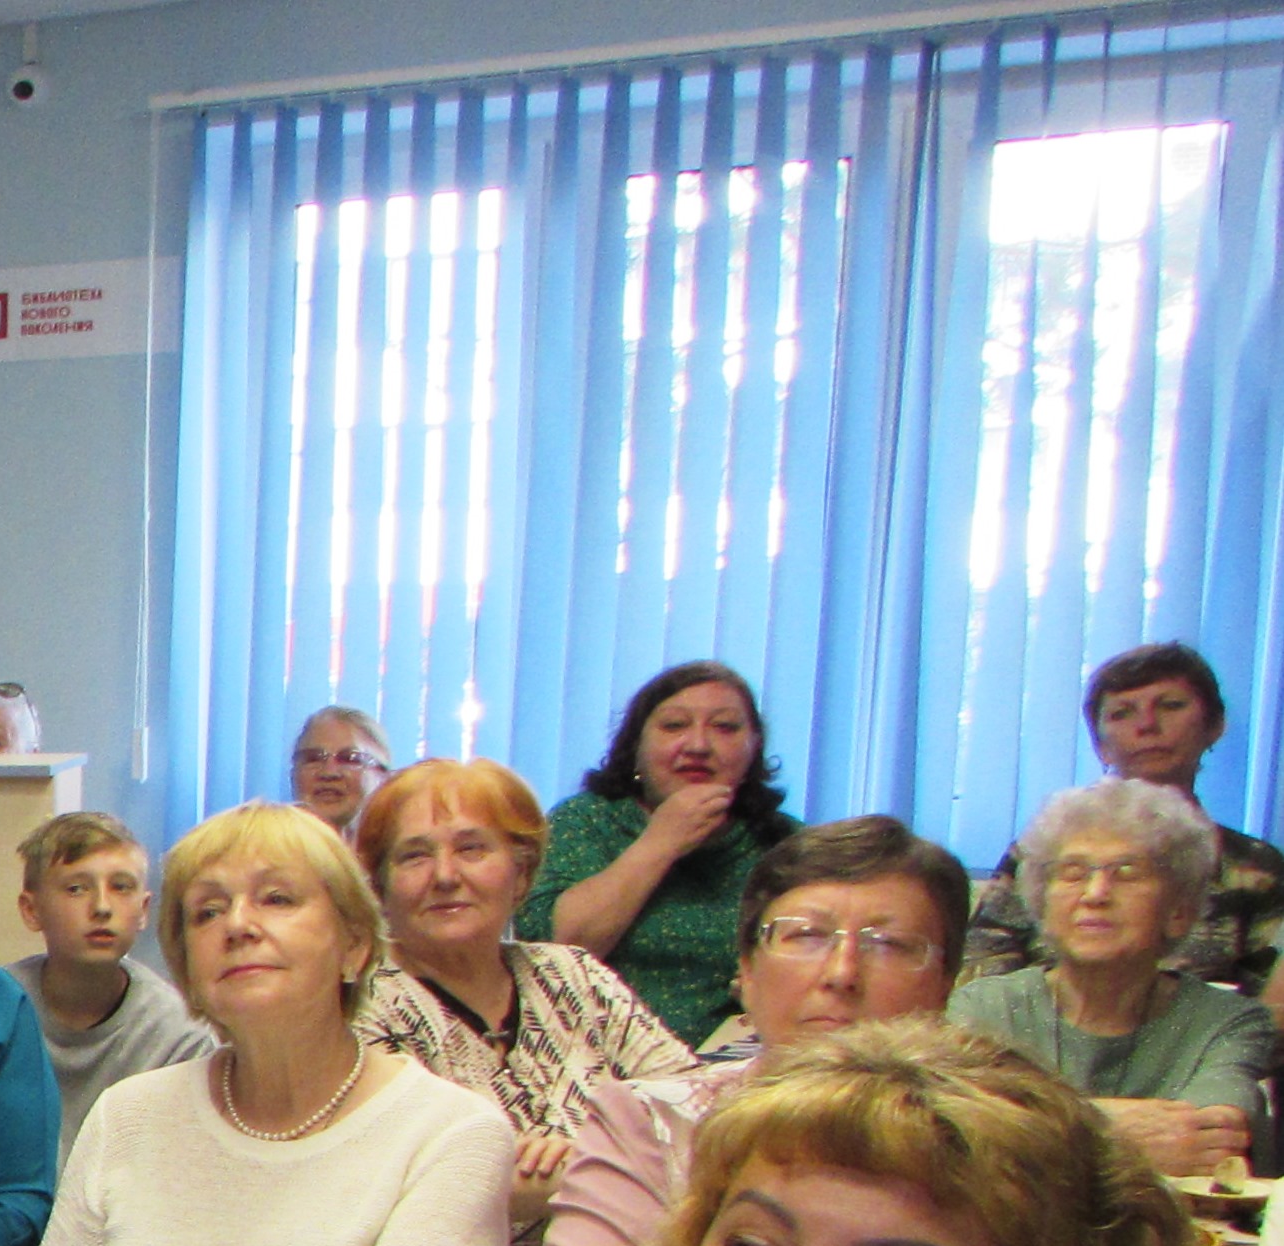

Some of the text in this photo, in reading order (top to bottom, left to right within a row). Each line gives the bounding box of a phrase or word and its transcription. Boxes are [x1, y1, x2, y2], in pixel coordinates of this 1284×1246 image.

[21, 288, 103, 305] БИБЛИОТЕКА
[21, 306, 71, 321] НОВОГО
[21, 320, 94, 336] ПОКОЛЕНИЯ
